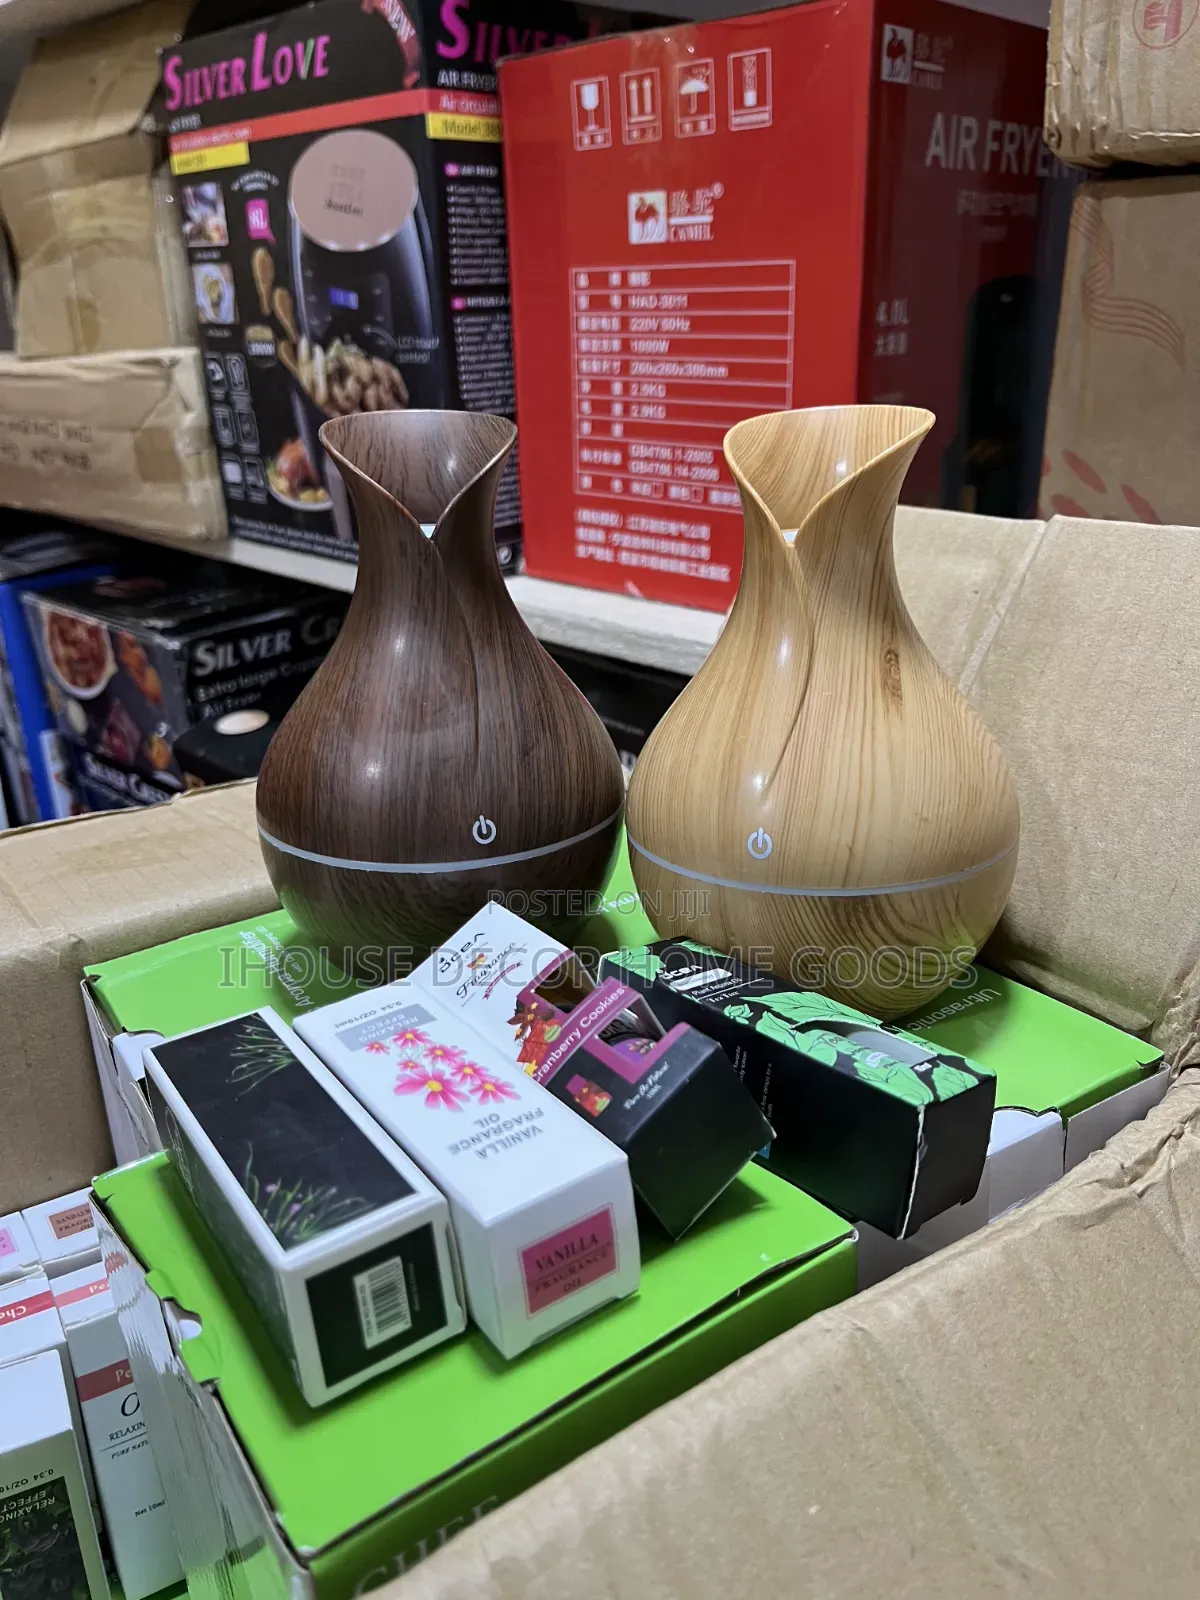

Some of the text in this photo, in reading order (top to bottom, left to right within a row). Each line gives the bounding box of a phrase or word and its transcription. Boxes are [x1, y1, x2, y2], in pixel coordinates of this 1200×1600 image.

[164, 31, 331, 111] SILVER LOVE
[924, 111, 979, 171] AIR
[194, 628, 293, 677] SILVER
[580, 987, 625, 1028] Cookies
[906, 988, 1002, 1031] Ultrasonic
[447, 1107, 545, 1156] FRAGRANCE
[473, 1112, 501, 1128] OIL
[475, 1125, 544, 1160] VANILLA
[535, 1232, 598, 1272] VANILLA
[111, 1446, 131, 1460] PURE
[33, 1469, 54, 1481] 0.34
[2, 1490, 47, 1513] EFFECT
